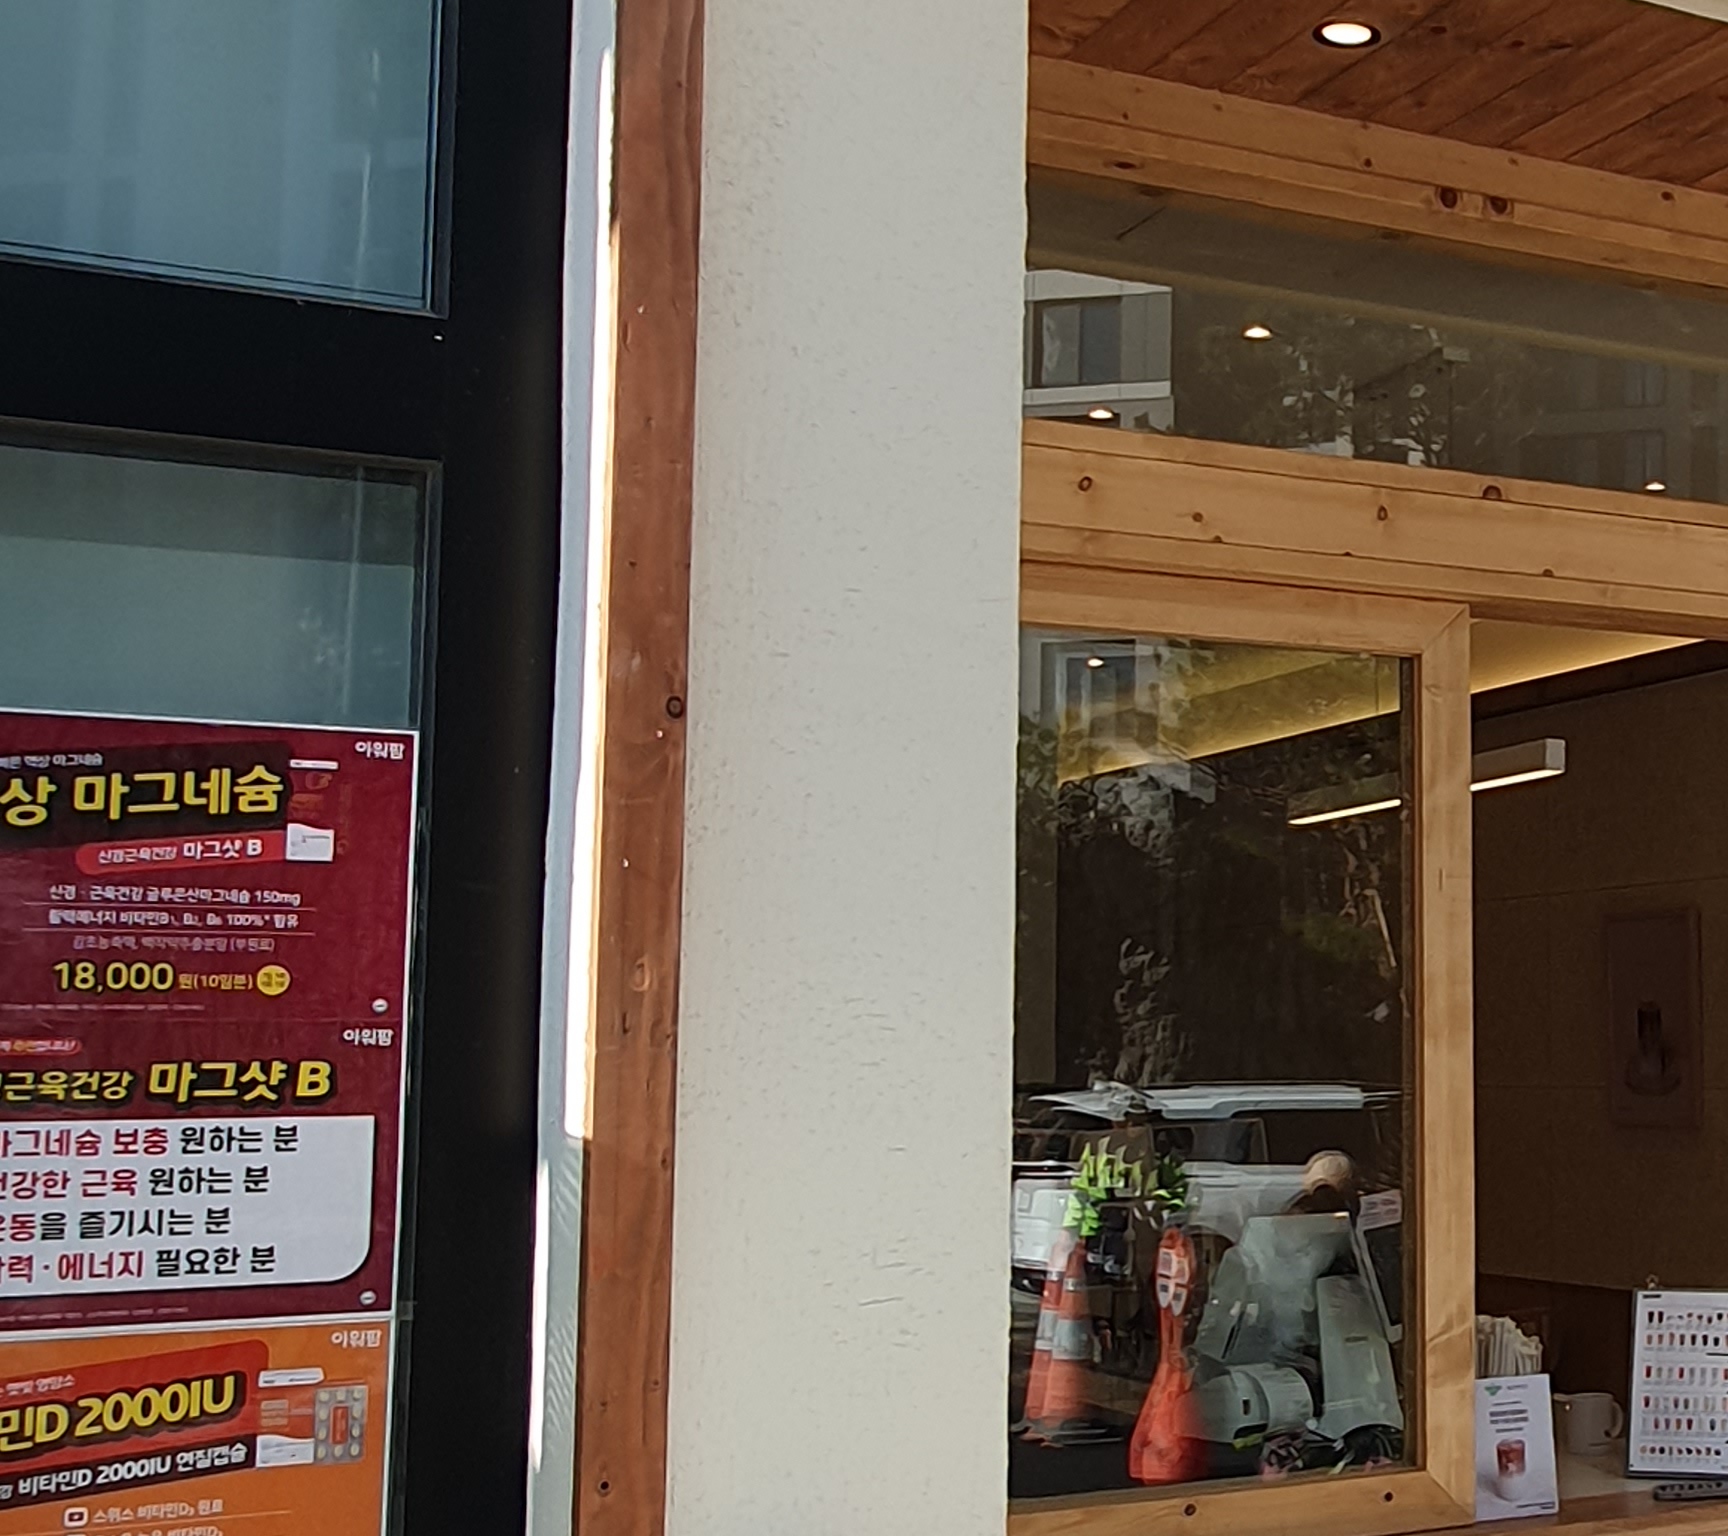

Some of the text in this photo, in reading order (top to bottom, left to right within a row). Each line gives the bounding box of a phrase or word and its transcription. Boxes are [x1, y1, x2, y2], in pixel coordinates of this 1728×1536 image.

[73, 765, 284, 820] 마그네슘
[183, 839, 242, 860] 마그샷
[246, 838, 264, 857] B
[53, 961, 174, 993] 18,000
[343, 1027, 394, 1047] 아워팜
[0, 1059, 332, 1103] 근육건강 마그샷 B
[112, 1127, 170, 1157] 보충
[179, 1125, 264, 1154] 원하는
[272, 1124, 300, 1154] 분
[80, 1168, 138, 1198] 근육
[148, 1166, 233, 1197] 원하는
[243, 1164, 271, 1194] 분
[0, 1206, 232, 1242] 동을 즐기시는 분
[57, 1251, 145, 1282] 에너지
[154, 1246, 242, 1279] 필요한
[250, 1244, 277, 1274] 분
[331, 1329, 383, 1349] 아워팜
[73, 1374, 235, 1438] 2000IU
[17, 1469, 92, 1496] 비타민D
[96, 1454, 172, 1485] 2000IU
